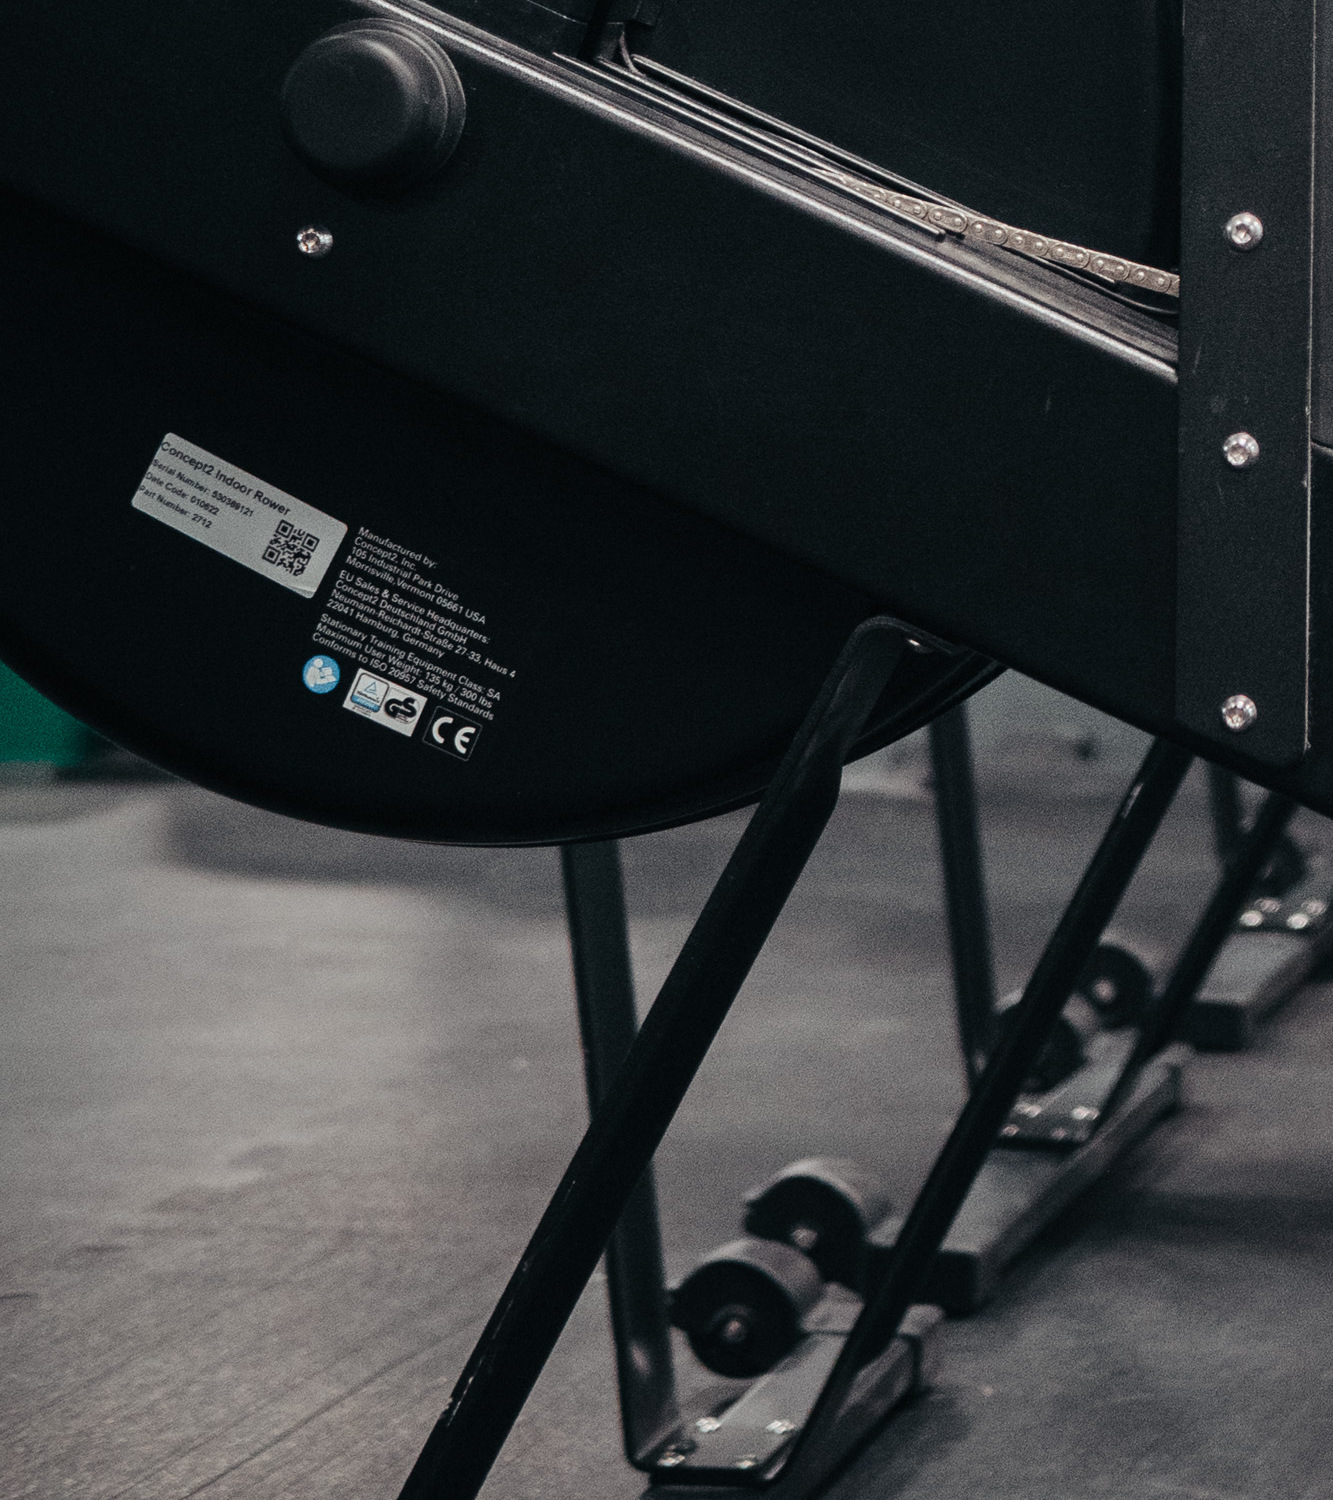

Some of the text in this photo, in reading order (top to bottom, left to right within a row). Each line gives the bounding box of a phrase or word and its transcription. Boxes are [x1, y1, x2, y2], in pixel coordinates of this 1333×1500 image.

[145, 471, 164, 487] Date
[164, 482, 189, 499] Code:
[151, 458, 176, 476] Serial
[175, 471, 210, 494] Number:
[160, 441, 291, 515] Concept2 Indoor Rower
[138, 484, 156, 499] Part
[191, 513, 212, 529] 2712
[352, 546, 459, 601] 105 Industrial Park Drive
[354, 536, 416, 570] Concept2, Inc.
[358, 526, 437, 570] Manufactured by:
[335, 579, 468, 644] Concept2 Deutschland GmbH
[338, 569, 354, 582] EU
[354, 576, 380, 594] Sales
[381, 588, 389, 598] &
[391, 593, 425, 615] Service
[435, 595, 464, 614] 05661
[464, 608, 485, 624] USA
[326, 598, 445, 658] 22041 Hamburg, Germany
[331, 588, 454, 650] Neumann-Reichardt-Straße
[484, 658, 508, 675] Haus
[509, 670, 516, 678] 4
[312, 632, 494, 720] Conforms to ISO 20957 Safety Standards
[316, 622, 362, 649] Maximum
[364, 644, 386, 659] User
[388, 654, 422, 676] Weight:
[425, 671, 441, 685] 135
[441, 679, 454, 692] kg
[459, 687, 478, 701] 300
[478, 695, 492, 708] lbs
[320, 613, 500, 701] Stationary Training Equipment Class: SA
